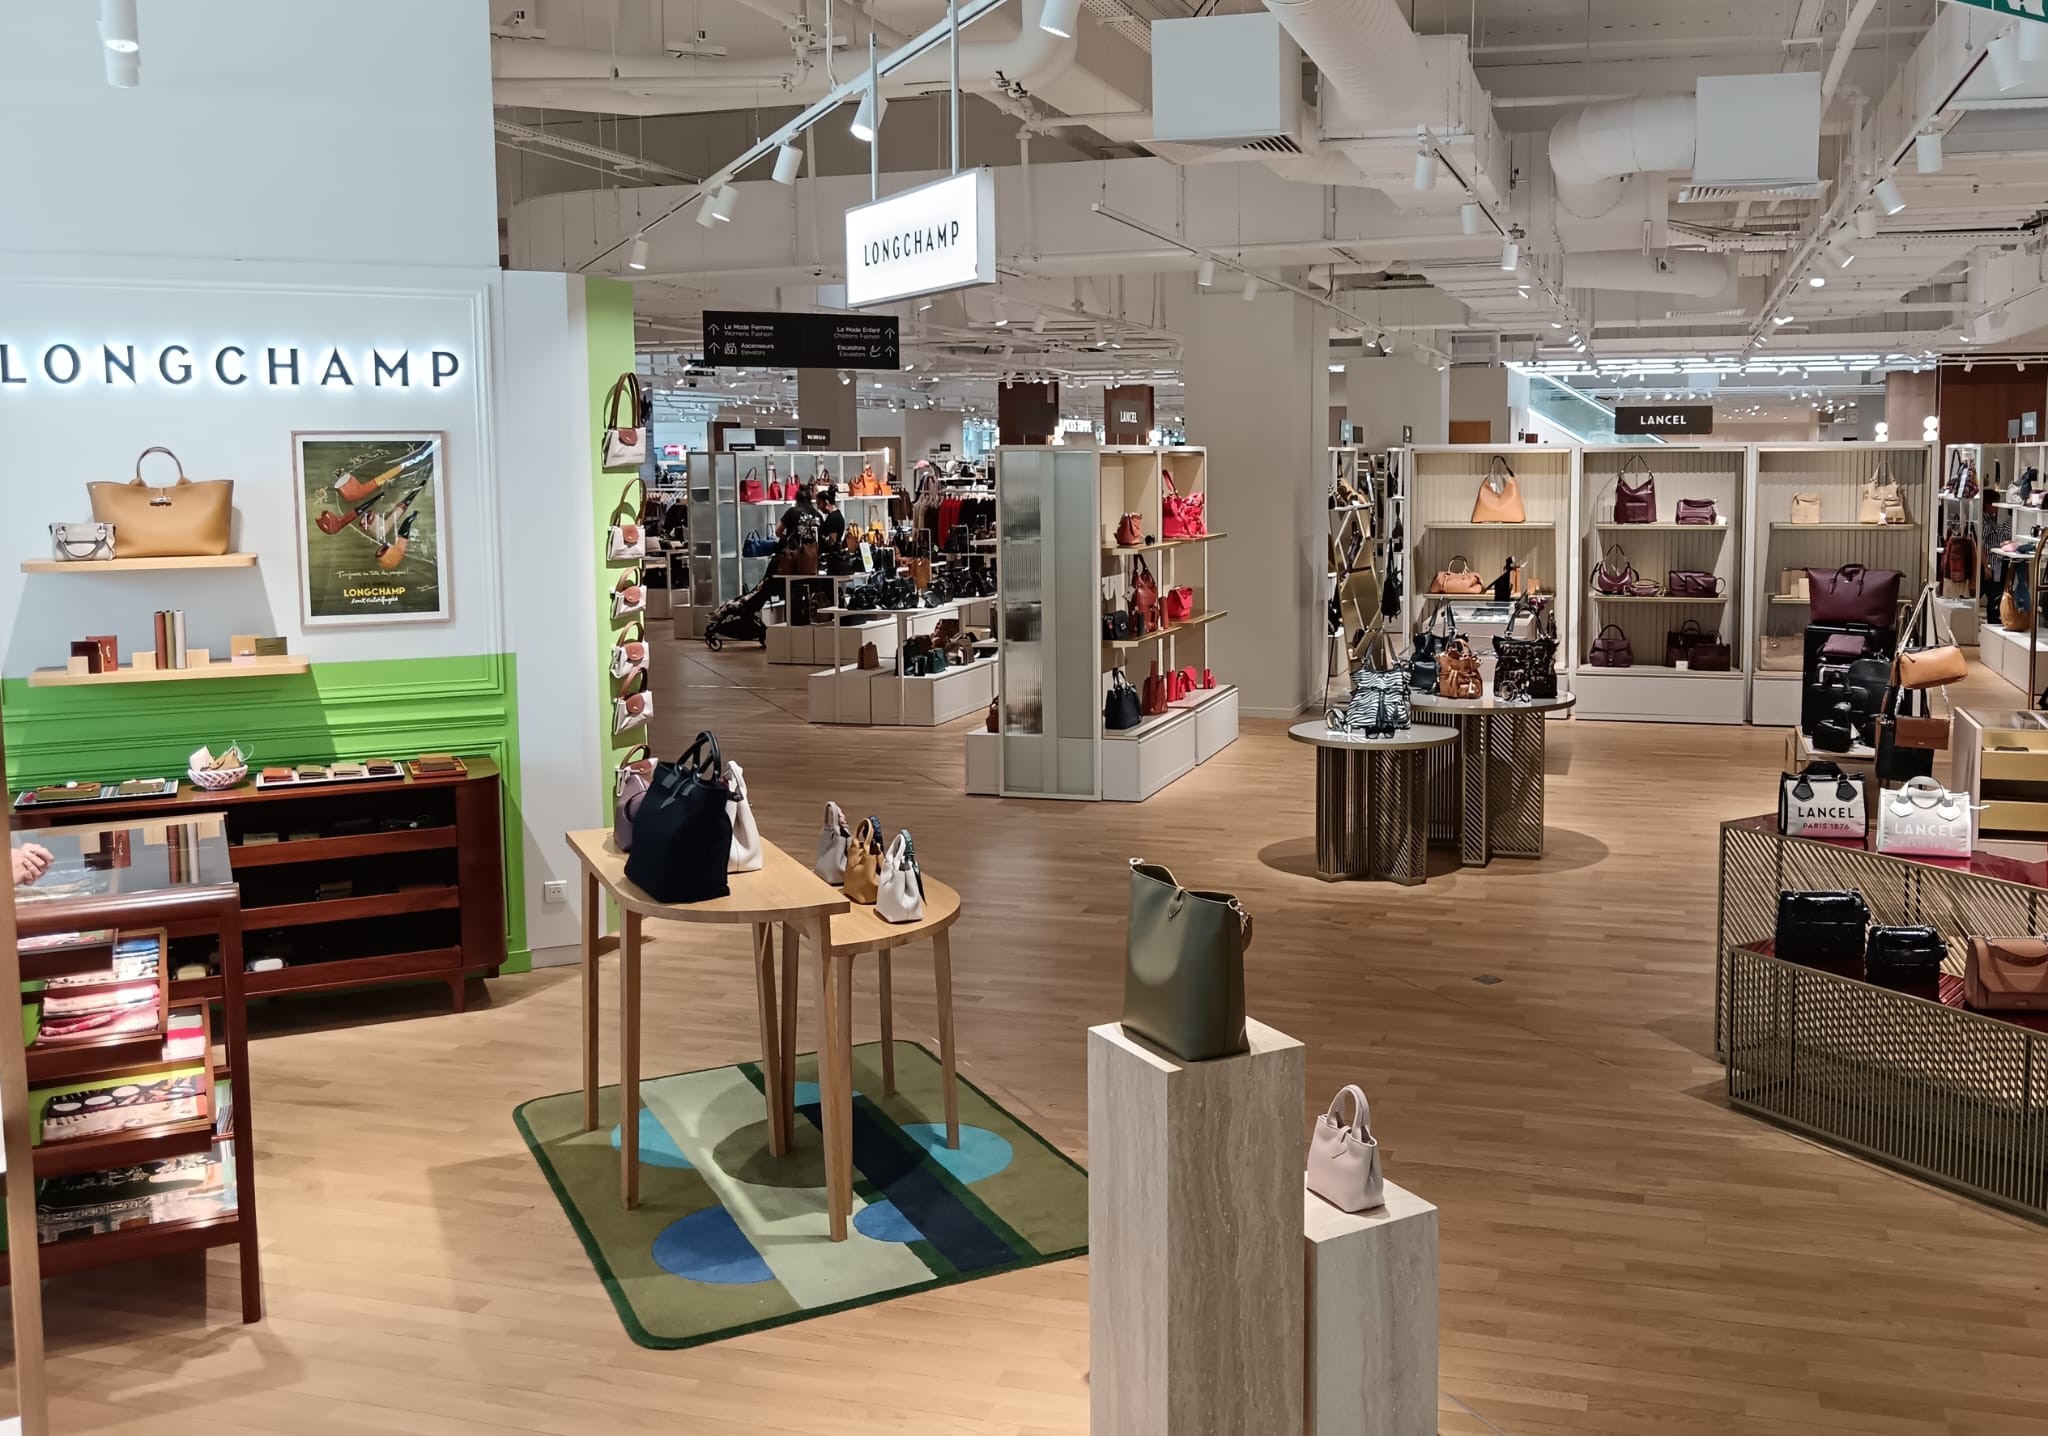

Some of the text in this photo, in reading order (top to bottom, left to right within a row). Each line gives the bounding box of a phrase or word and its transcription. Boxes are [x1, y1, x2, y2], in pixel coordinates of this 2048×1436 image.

[864, 220, 959, 267] LONGCHAMP
[0, 343, 460, 387] LONGCHAMP
[1119, 410, 1138, 423] LANCEL
[1640, 415, 1687, 425] LANCEL
[343, 586, 406, 597] LONGCHAMP
[1798, 806, 1855, 819] LANCEL
[1803, 822, 1850, 830] PARIS 1876
[1894, 822, 1957, 837] LANCEL
